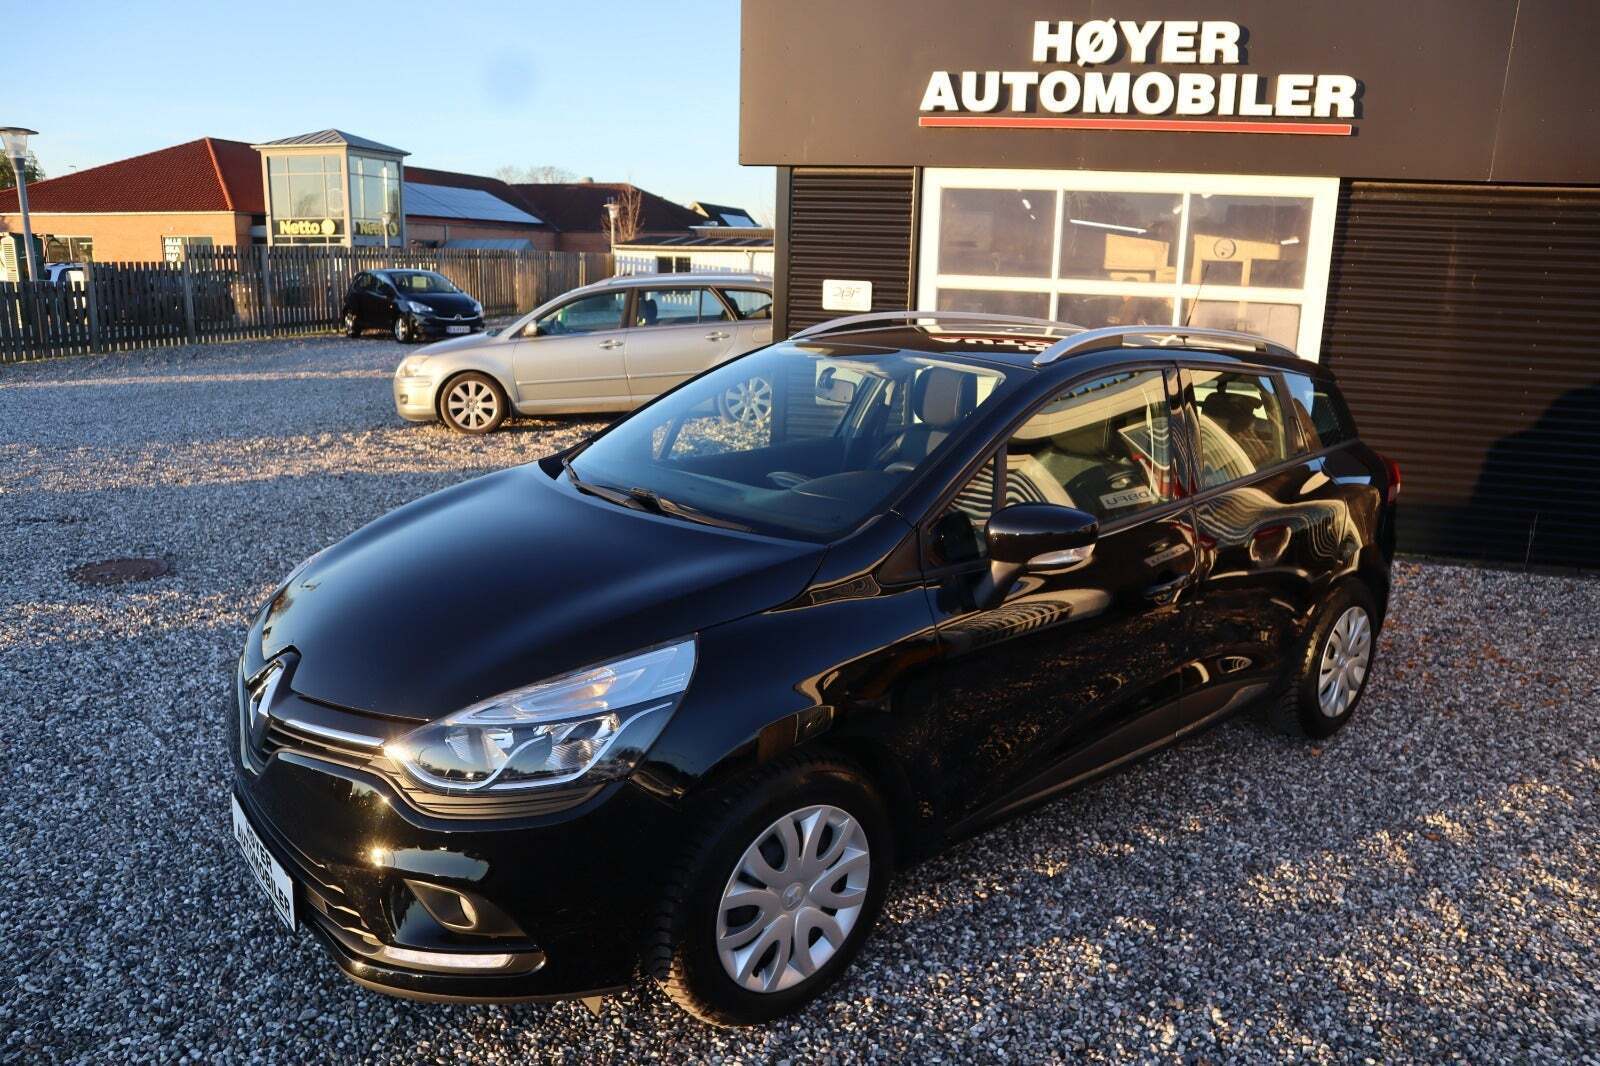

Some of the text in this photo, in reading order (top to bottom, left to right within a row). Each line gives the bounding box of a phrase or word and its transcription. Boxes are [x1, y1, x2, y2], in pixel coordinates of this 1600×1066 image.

[1032, 17, 1240, 66] HØYER
[919, 70, 1358, 118] AUTOMOBILER
[280, 220, 320, 235] Netto
